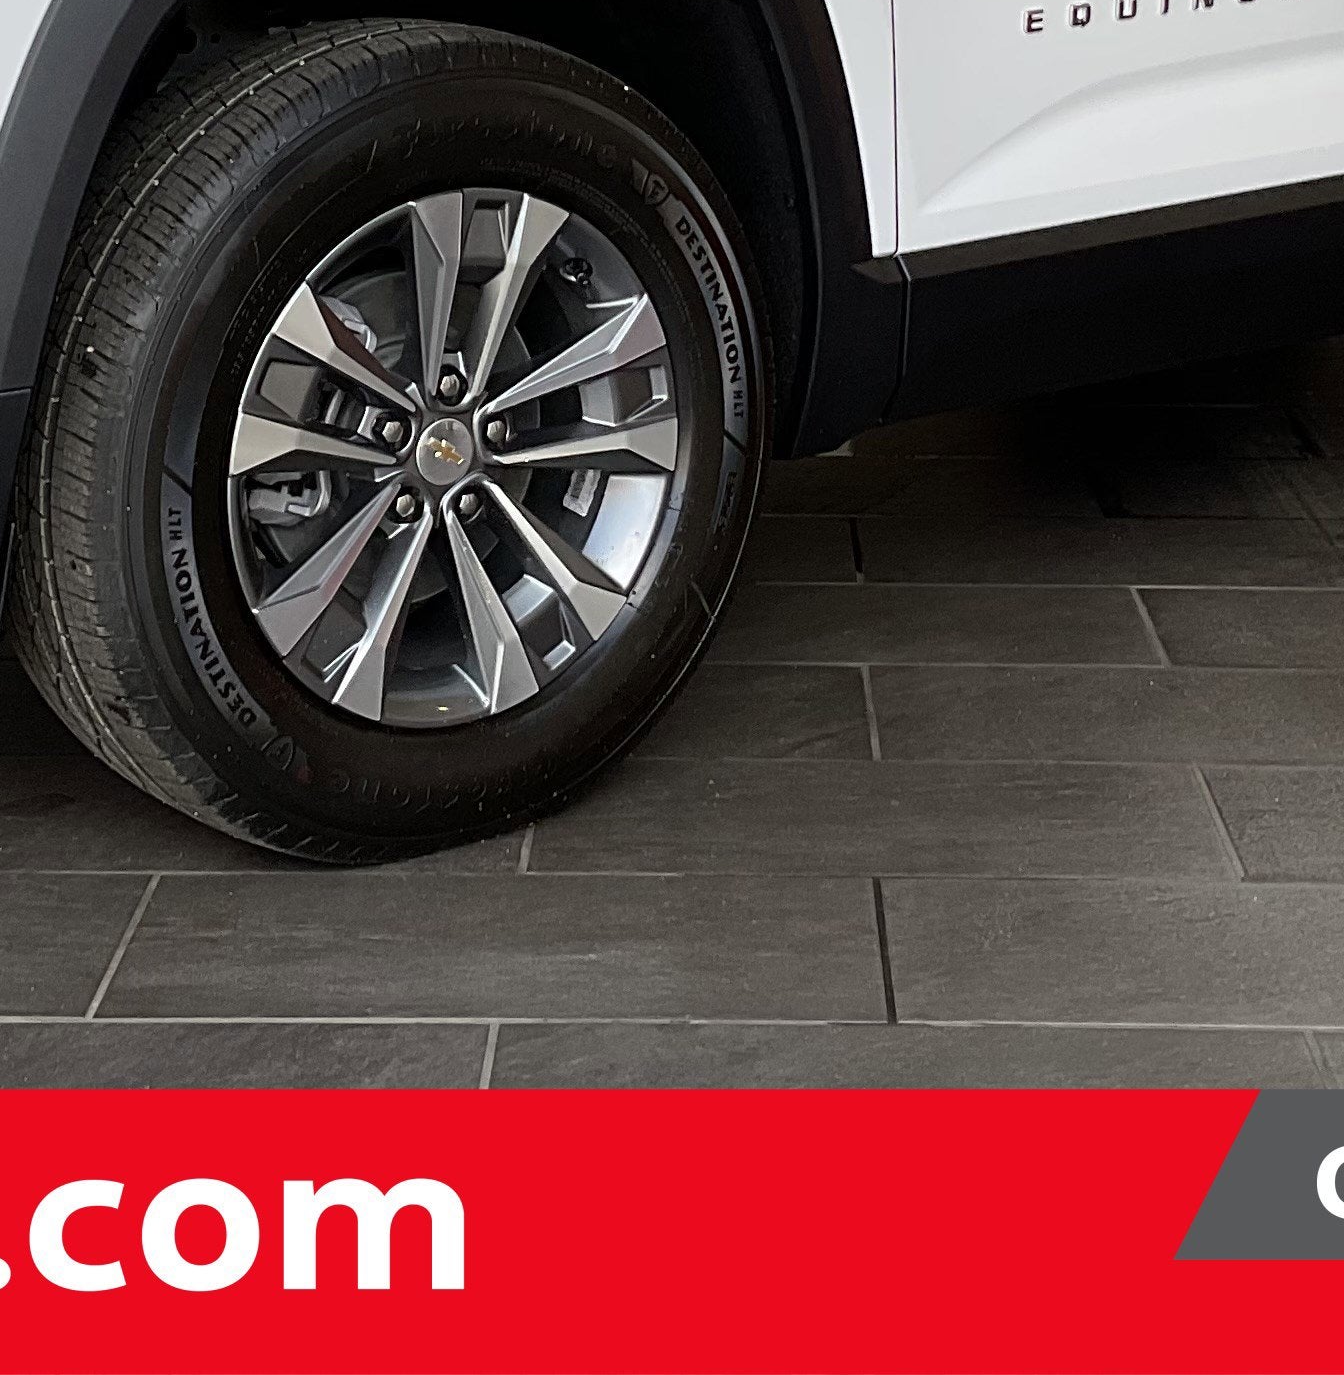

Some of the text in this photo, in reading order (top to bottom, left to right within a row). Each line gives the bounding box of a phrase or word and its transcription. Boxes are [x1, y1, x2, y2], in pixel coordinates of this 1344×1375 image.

[675, 215, 744, 418] DESTINATION HLT
[168, 507, 256, 726] DESTINATION HLT
